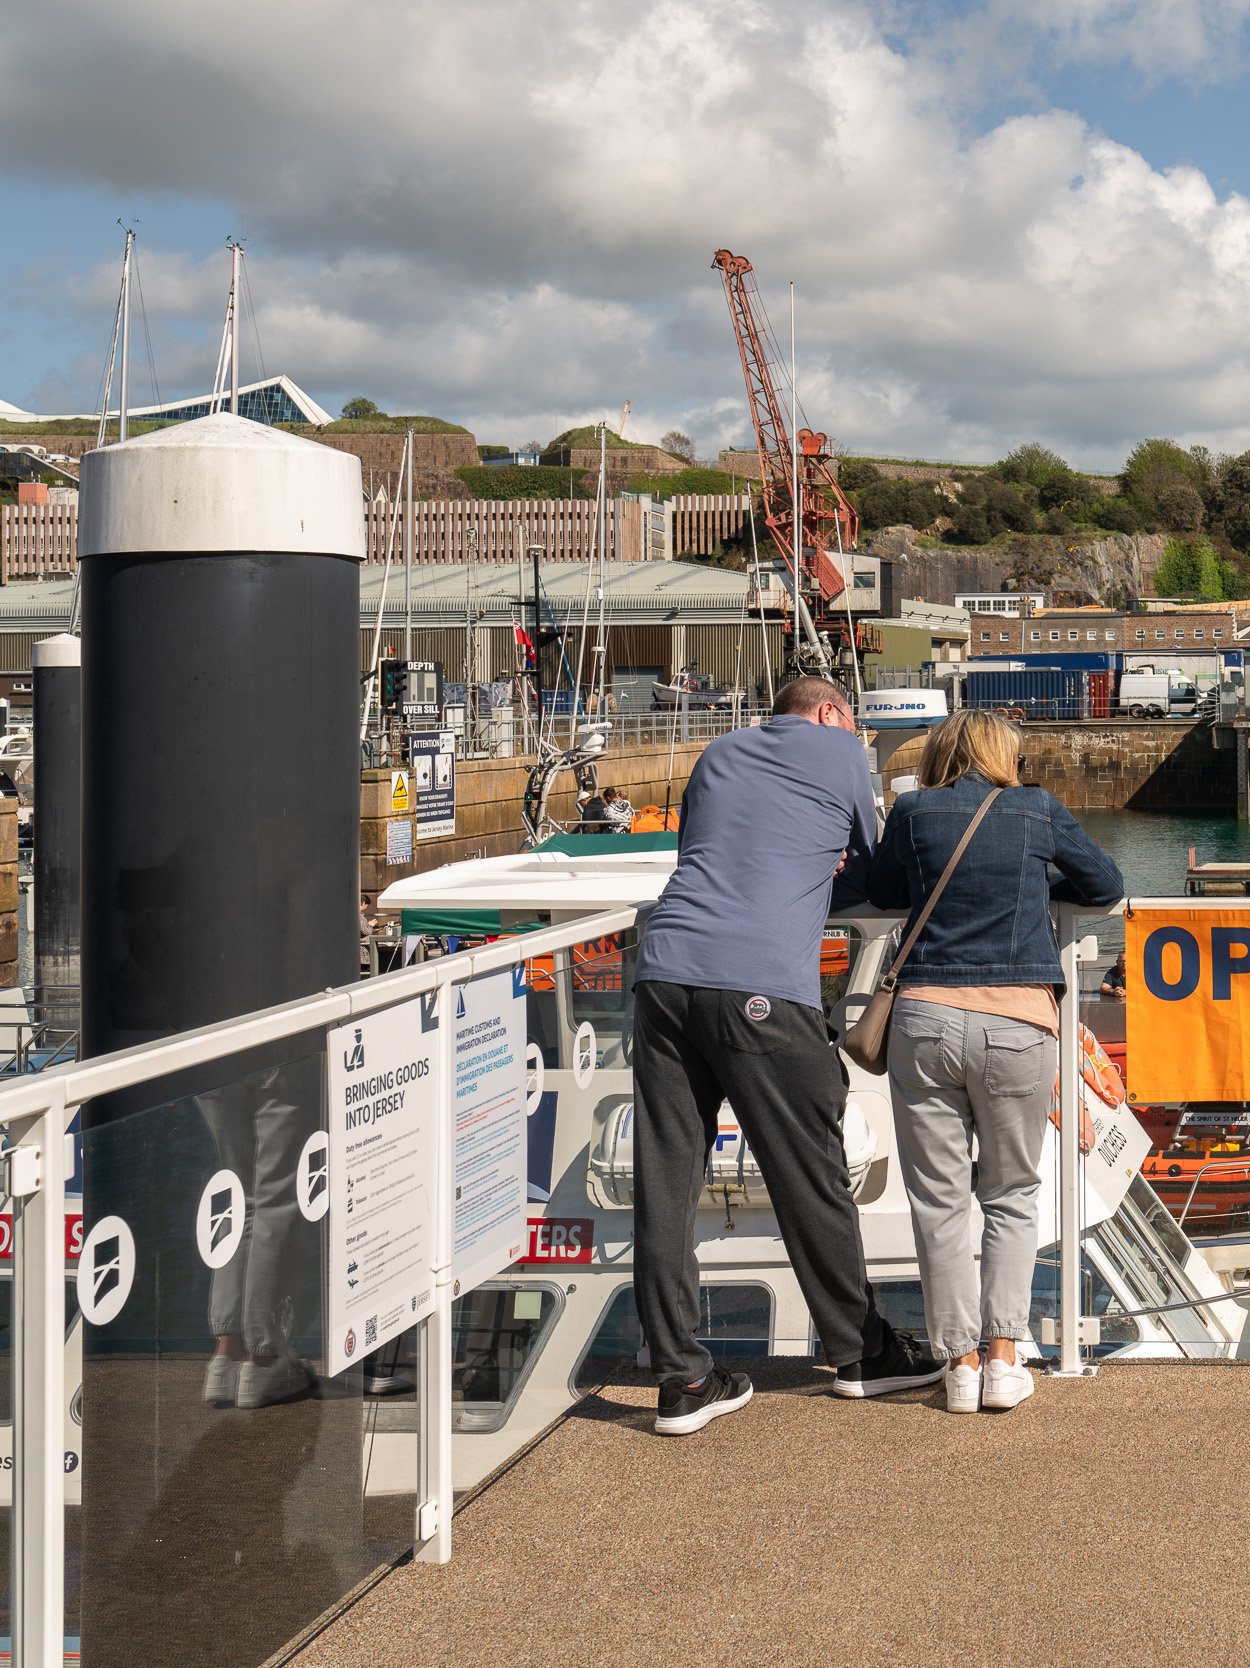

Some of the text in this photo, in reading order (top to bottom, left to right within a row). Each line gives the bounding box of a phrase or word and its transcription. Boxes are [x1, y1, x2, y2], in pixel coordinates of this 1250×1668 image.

[407, 662, 434, 671] DEPTH
[403, 705, 440, 714] OVER SILL
[413, 739, 440, 749] ATTENTION
[456, 1016, 502, 1041] MARITIME CUSTOMS AND
[456, 1027, 507, 1054] IMMIGRATION DECLARATION
[492, 1054, 514, 1069] PASSAGERS
[345, 1058, 429, 1106] BRINGING GOODS
[456, 1082, 478, 1099] MARITIMES
[346, 1090, 405, 1131] INTO JERSEY
[1098, 1124, 1127, 1168] DUCHESS
[526, 1225, 581, 1257] TERS
